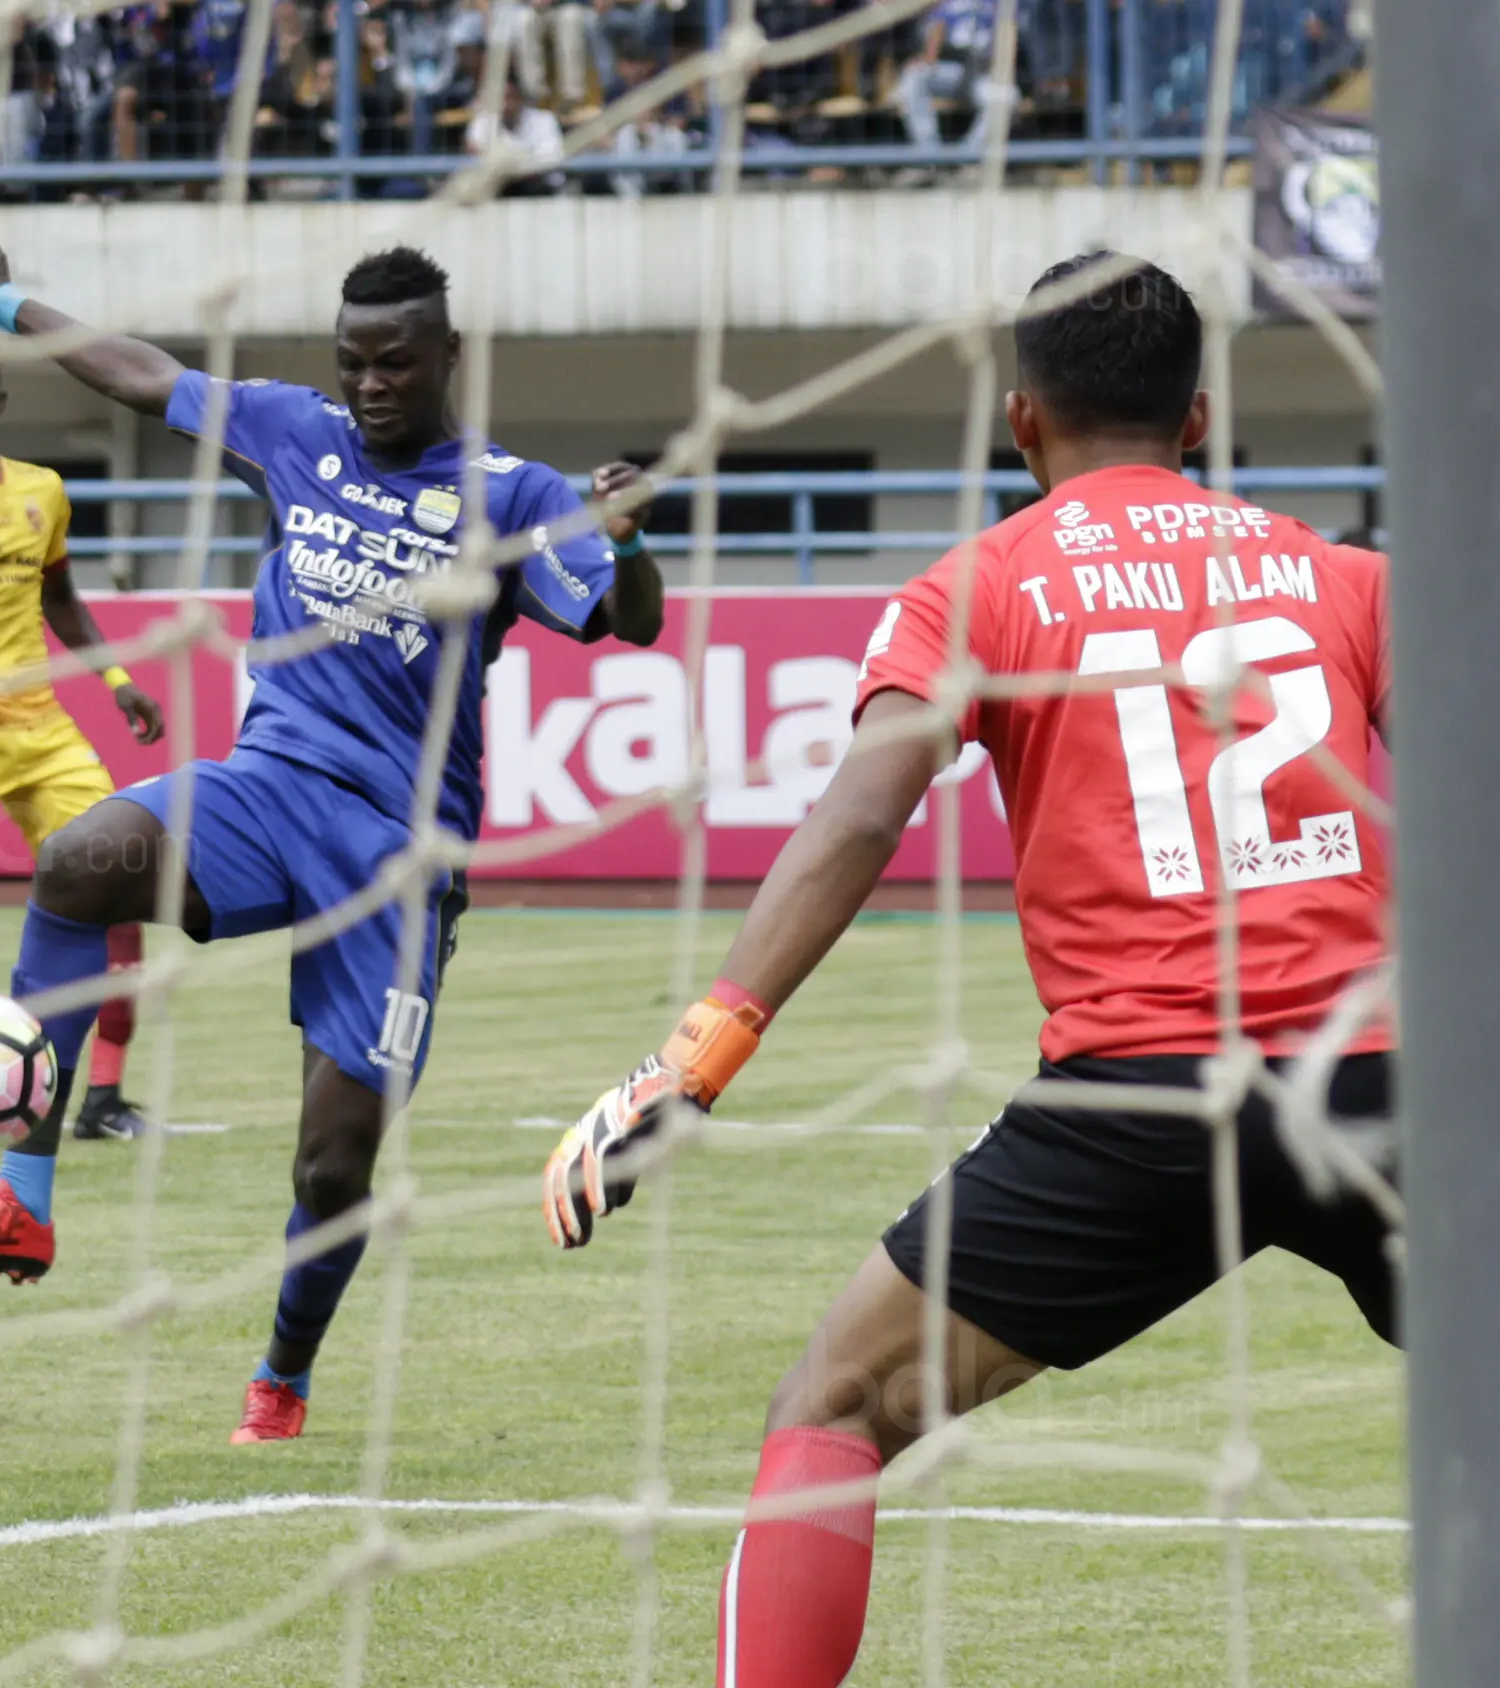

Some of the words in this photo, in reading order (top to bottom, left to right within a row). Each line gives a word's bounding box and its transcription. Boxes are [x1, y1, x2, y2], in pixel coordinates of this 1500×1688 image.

[1053, 523, 1116, 549] pgn
[1126, 503, 1271, 532] PDPDE
[1141, 526, 1269, 545] SUMSEL
[1020, 576, 1066, 625] T.
[1073, 560, 1184, 613] PAKU
[1206, 554, 1318, 607] ALAM
[1077, 616, 1362, 897] 12
[379, 987, 430, 1062] 10
